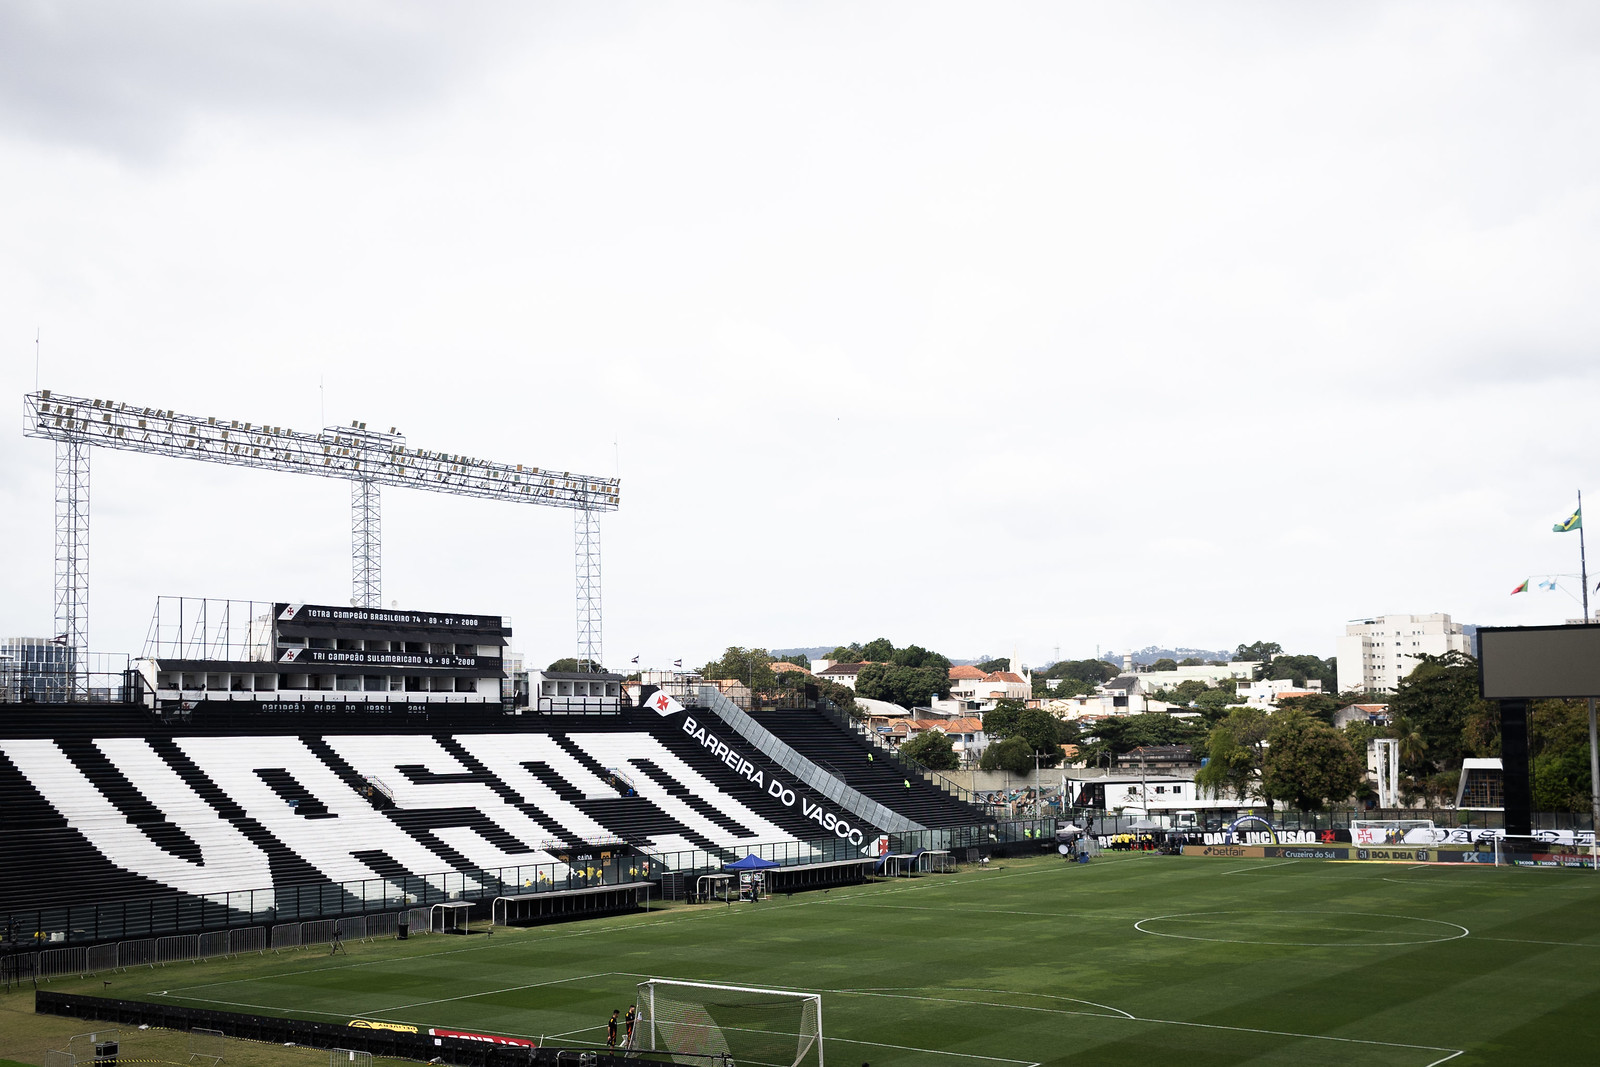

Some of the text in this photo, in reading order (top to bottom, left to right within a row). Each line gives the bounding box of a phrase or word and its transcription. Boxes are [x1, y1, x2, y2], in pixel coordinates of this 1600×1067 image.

[682, 716, 864, 846] BARREIRA DO VASCO
[1212, 847, 1245, 857] betfair
[1285, 850, 1313, 858] Cruzeiro
[1324, 851, 1335, 859] Sul
[1359, 850, 1427, 860] 51 BOA IDEIA 51
